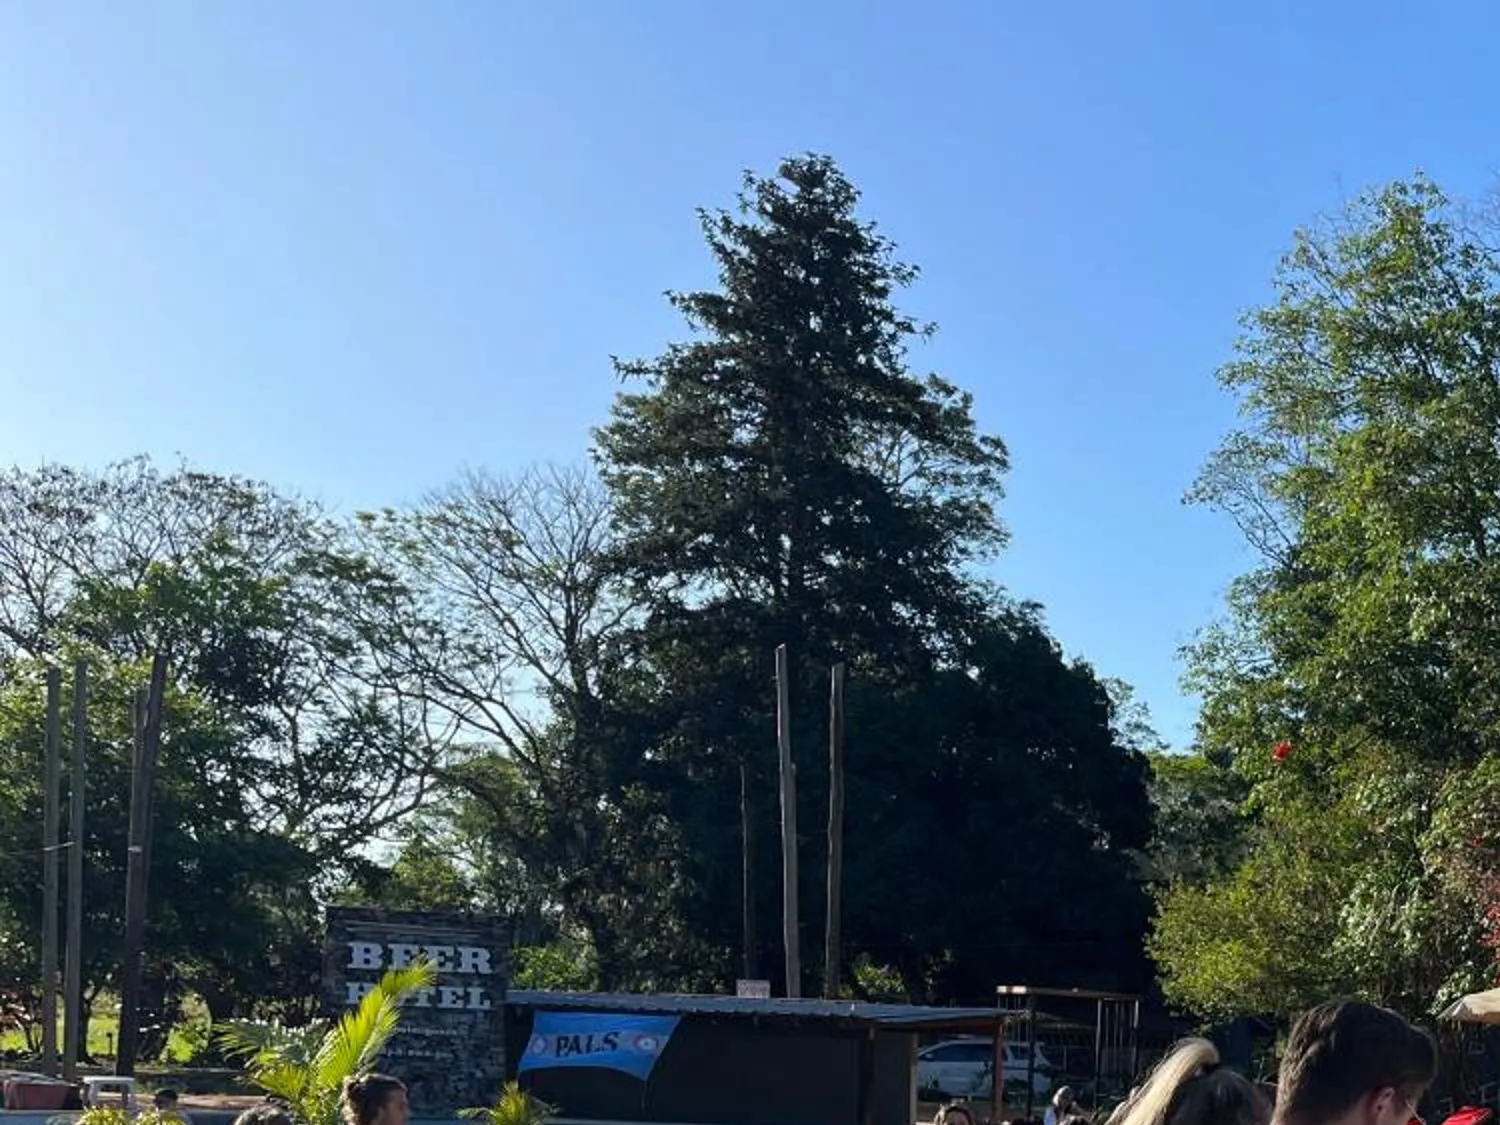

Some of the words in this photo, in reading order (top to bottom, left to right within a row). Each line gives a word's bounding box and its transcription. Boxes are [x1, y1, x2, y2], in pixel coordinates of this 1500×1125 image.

[347, 942, 492, 973] BEER
[345, 982, 491, 1009] HTEL
[556, 1032, 620, 1057] PALS
